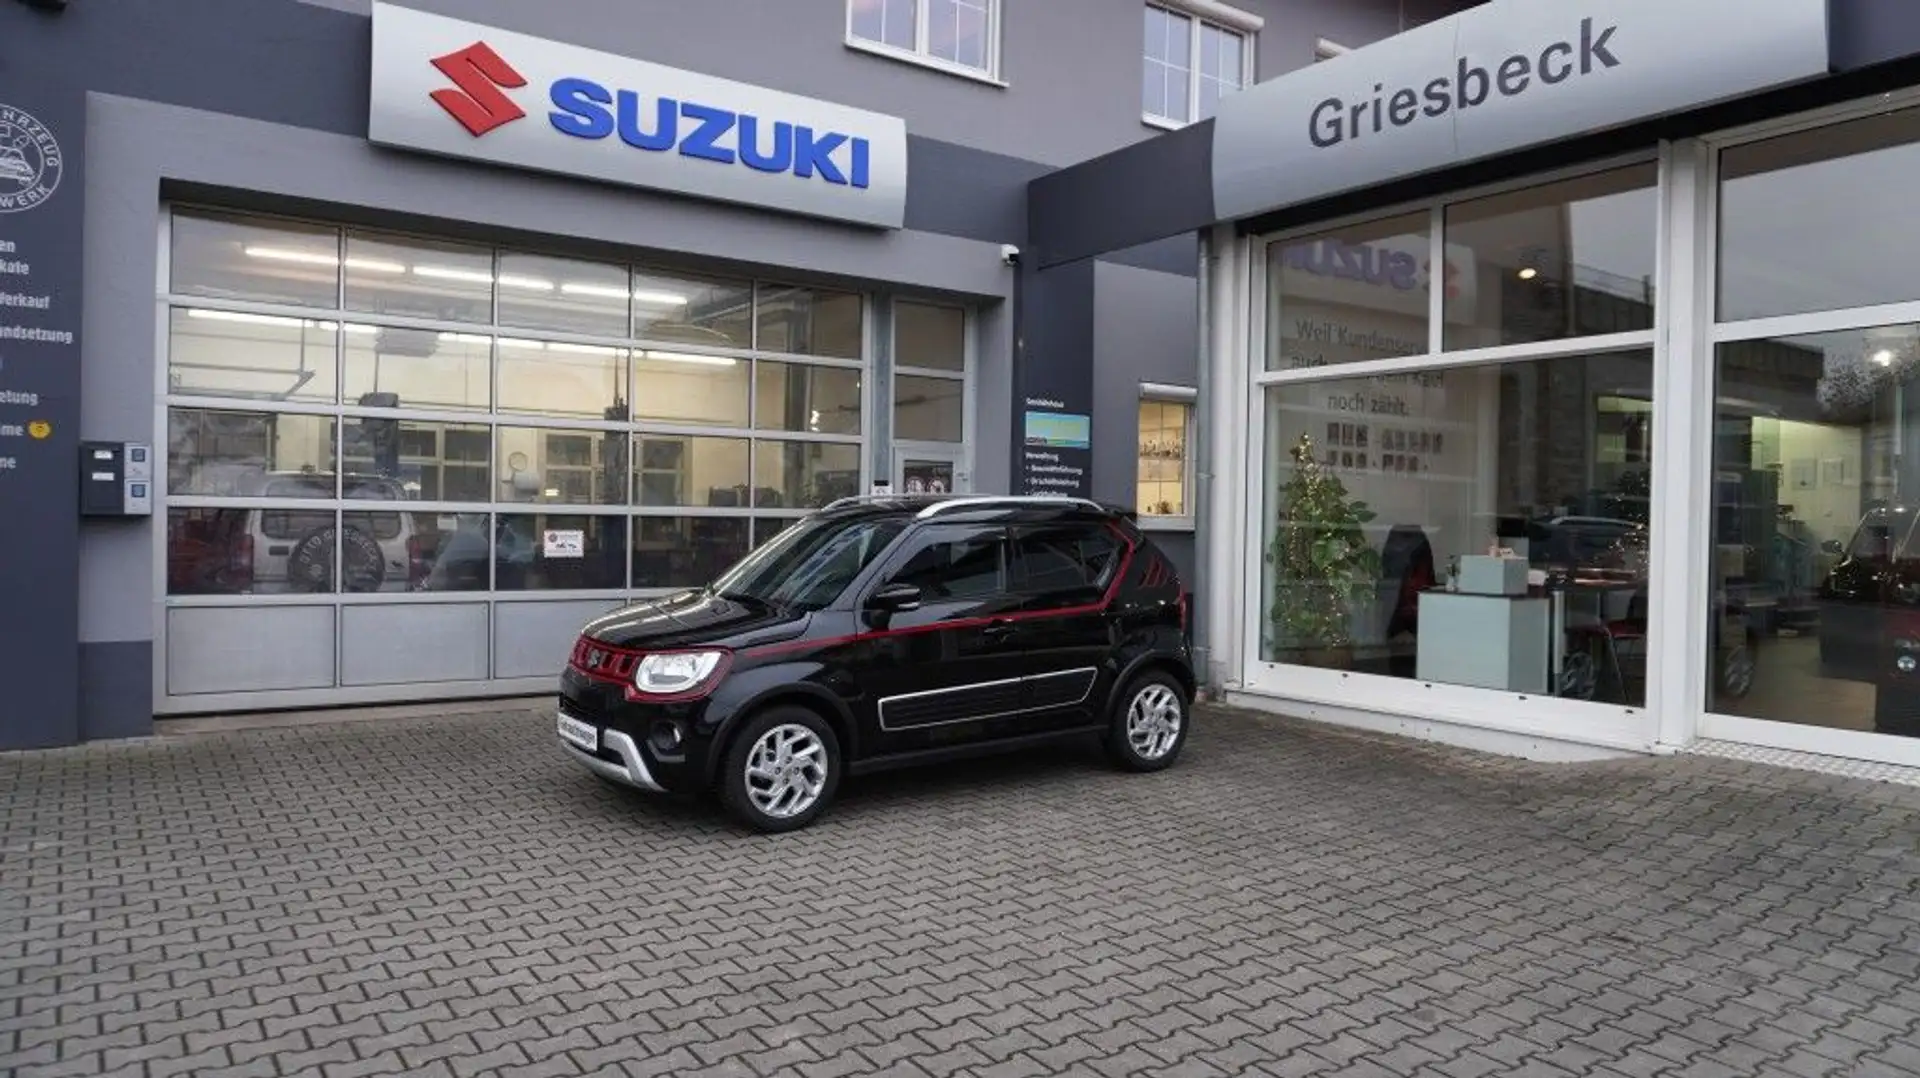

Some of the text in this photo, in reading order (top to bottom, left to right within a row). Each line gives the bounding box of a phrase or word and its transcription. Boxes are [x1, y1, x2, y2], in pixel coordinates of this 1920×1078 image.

[548, 77, 869, 189] SUZUKI
[1308, 17, 1621, 148] Griesbeck
[1328, 393, 1364, 412] noch
